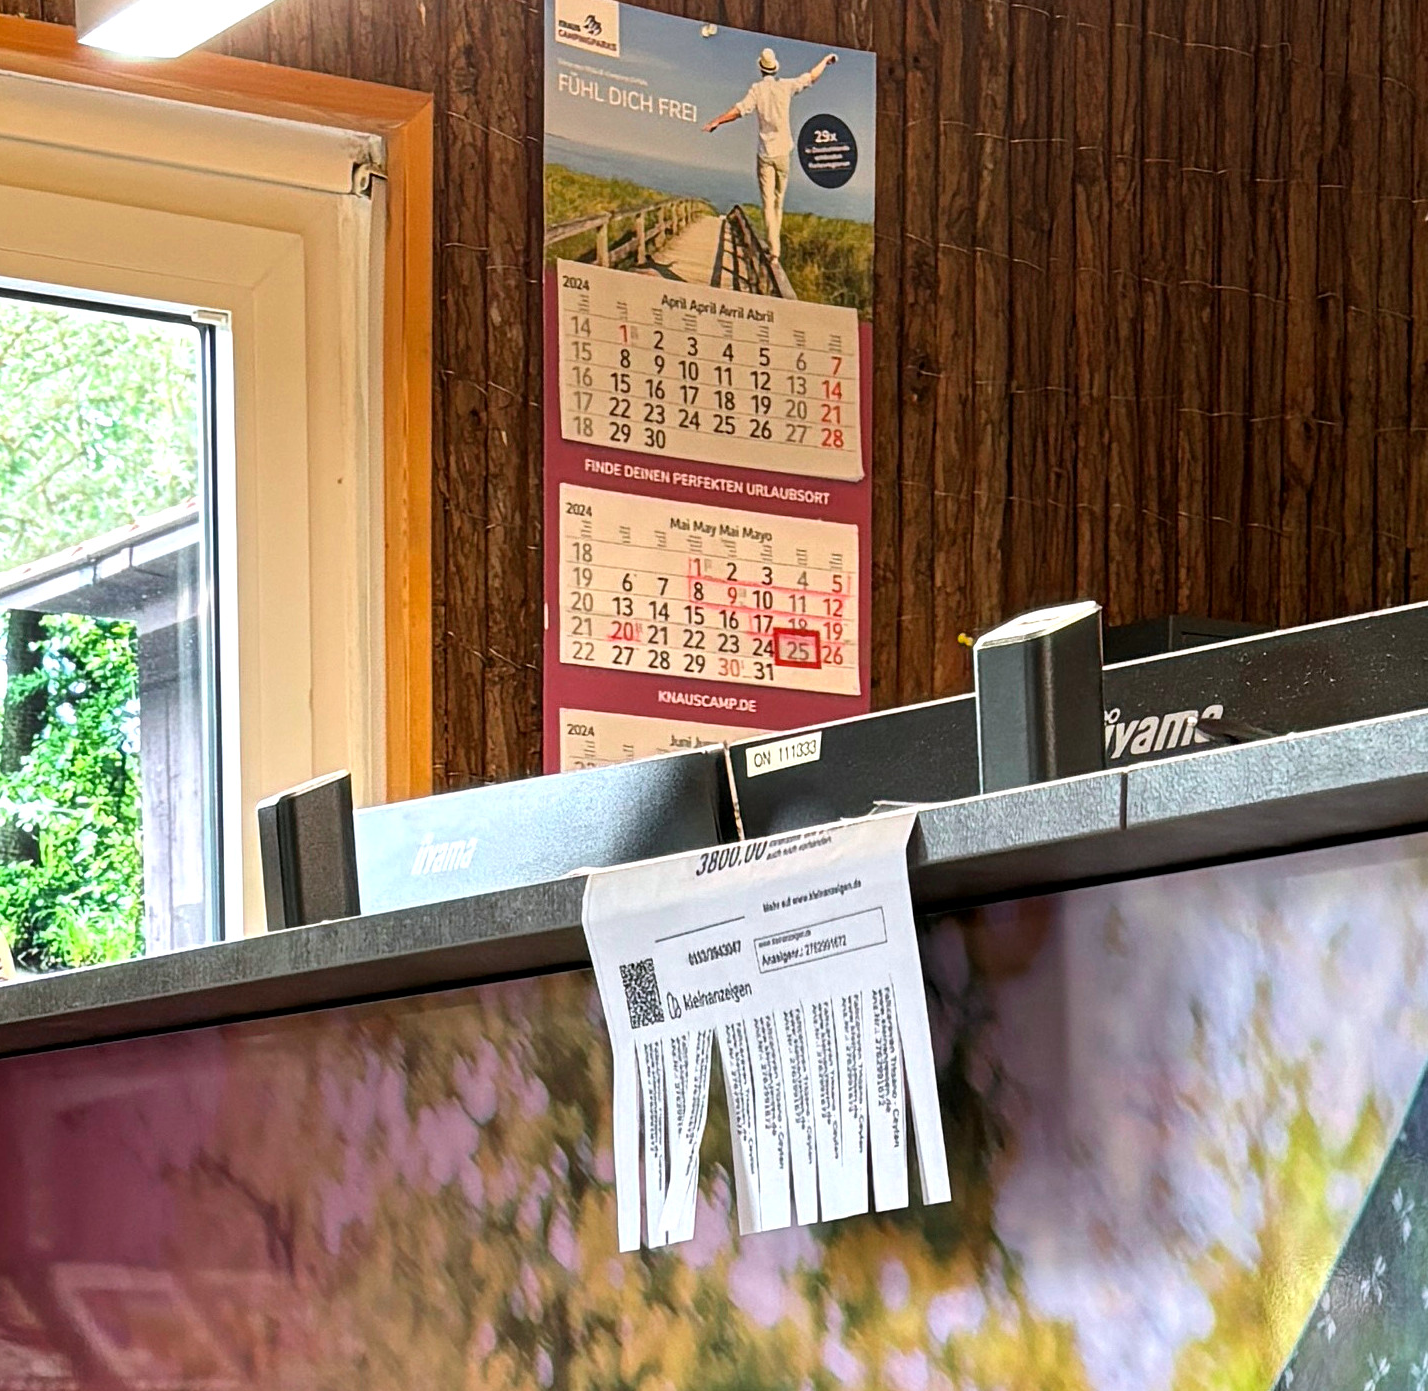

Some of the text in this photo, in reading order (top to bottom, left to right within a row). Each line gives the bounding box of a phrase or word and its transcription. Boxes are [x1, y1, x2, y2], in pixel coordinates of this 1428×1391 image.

[559, 71, 604, 102] FÜHL
[609, 86, 653, 113] DICH
[659, 98, 697, 122] FREI
[563, 275, 589, 291] 2024
[662, 295, 774, 322] April April Avril Abril
[572, 316, 842, 375] 14 1 2 3 4 5 6 7
[572, 342, 842, 399] 15 8 9 10 11 12 13 14
[573, 367, 841, 424] 16 15 16 17 18 19 20 21
[574, 392, 844, 448] 17 22 23 24 25 26 27 28
[574, 417, 665, 449] 18 29 30
[584, 459, 830, 505] FINDE DEINEN PERFEKTEN URLAUBSORT
[566, 503, 593, 518] 2024
[670, 518, 772, 543] Mai May Mai Mayo
[573, 543, 842, 593] 18 1 2 3 4 5
[573, 568, 842, 617] 19 6 7 8 9 10 11 12
[572, 592, 593, 612] 20
[613, 598, 633, 617] 13
[649, 602, 669, 621] 14
[684, 606, 704, 625] 15
[719, 610, 738, 629] 16
[753, 615, 773, 633] 17
[824, 622, 842, 640] 19
[572, 617, 843, 664] 21 20 21 22 23 24 25 26
[573, 642, 774, 681] 22 27 28 29 30 31
[658, 690, 757, 713] KNAUSCAMP.DE
[567, 724, 595, 737] 2024
[670, 735, 691, 747] Juni
[1104, 705, 1224, 759] iyama
[754, 739, 817, 768] ON 111333
[683, 982, 753, 1012] kleinanzeigen
